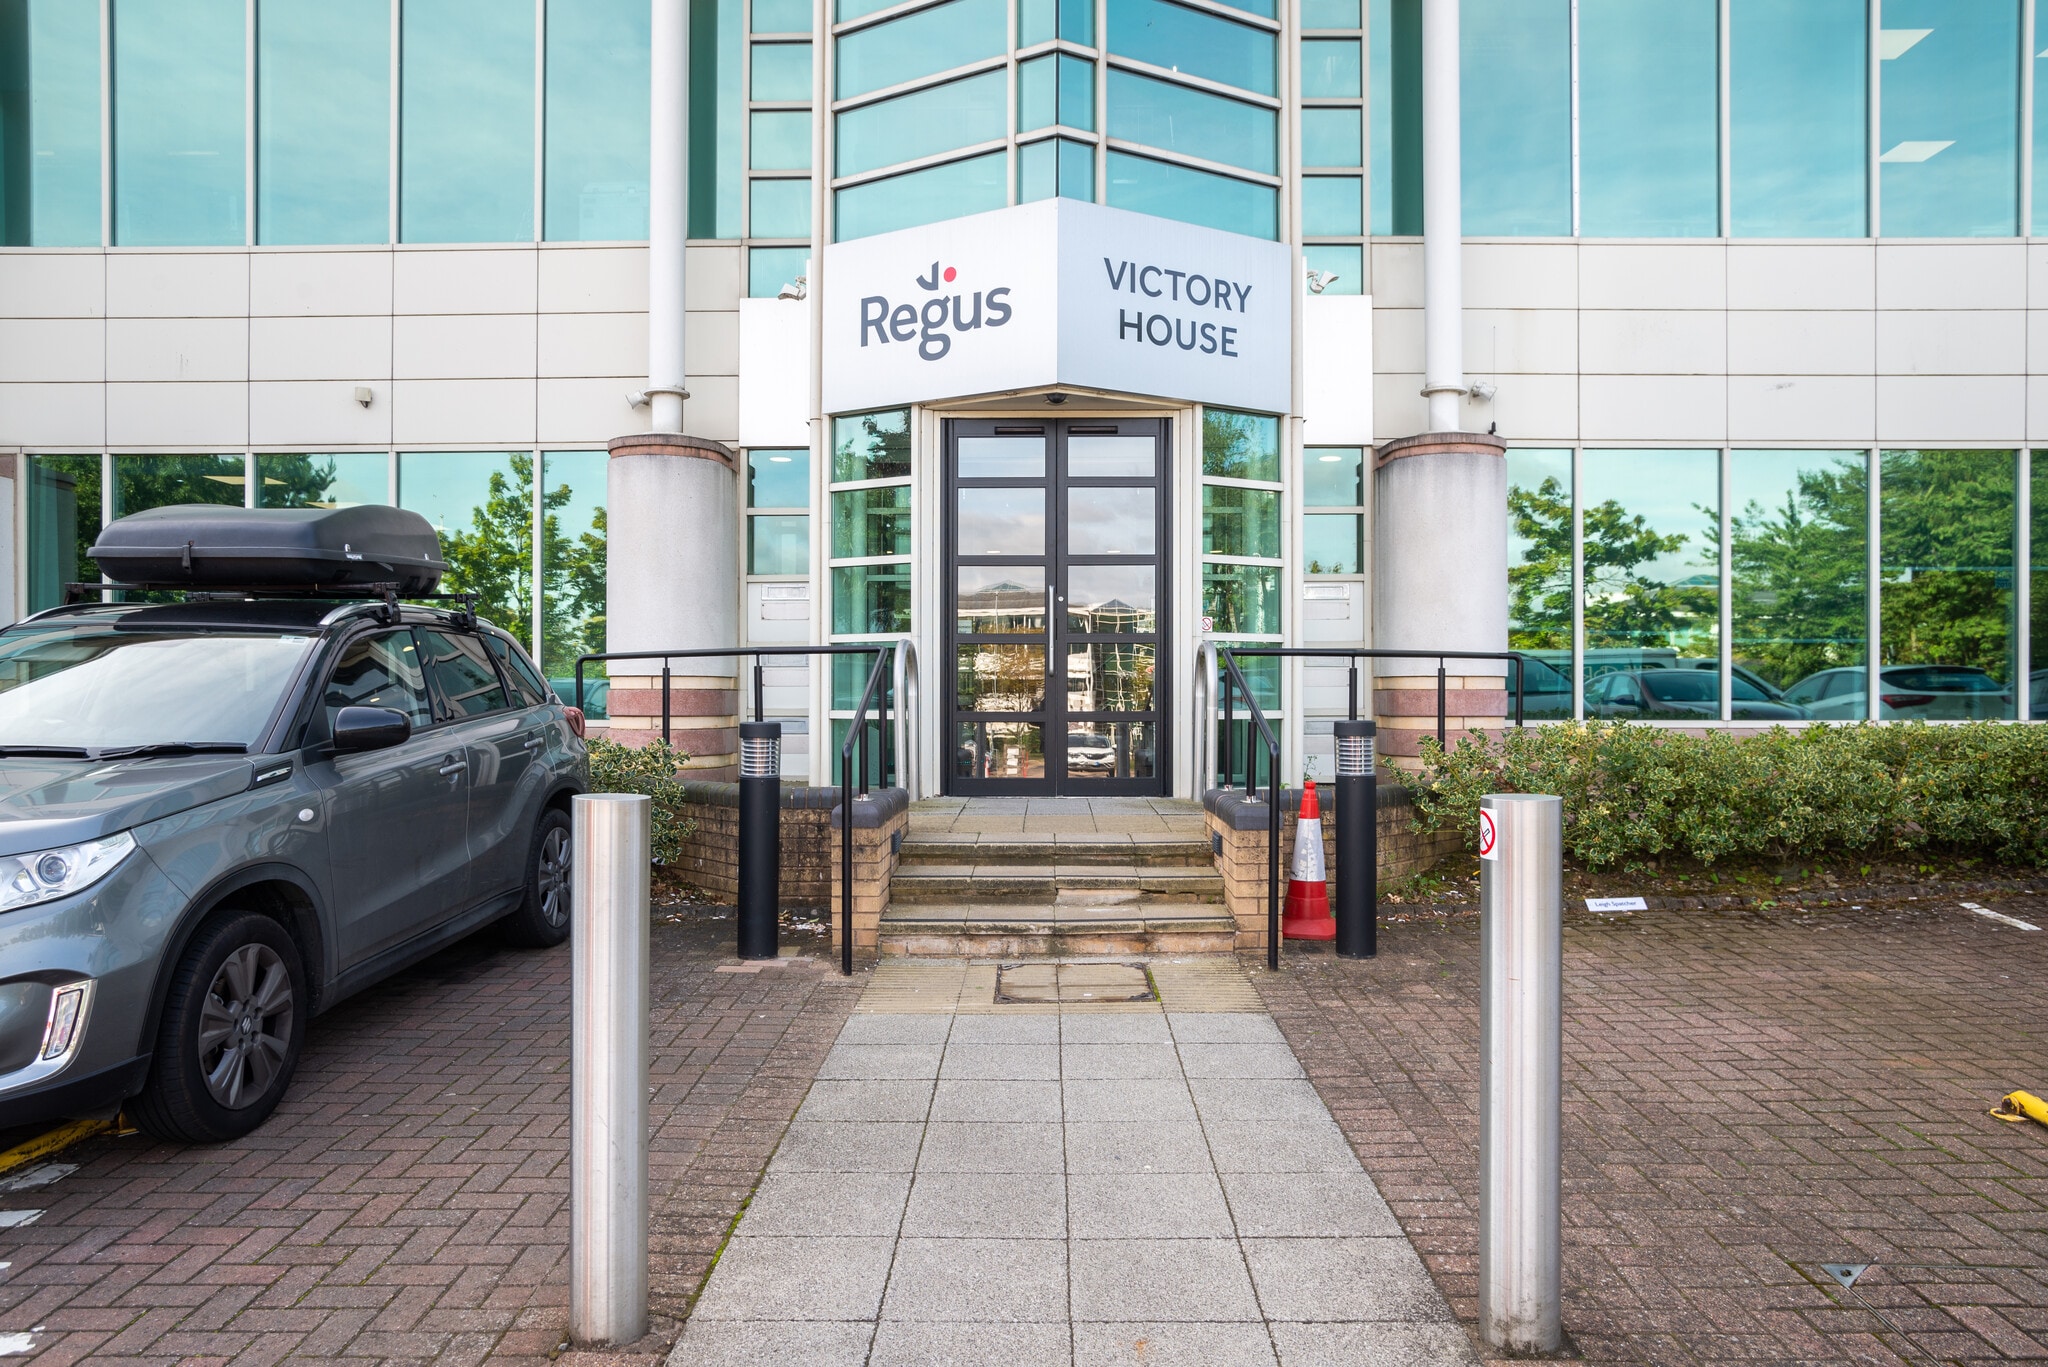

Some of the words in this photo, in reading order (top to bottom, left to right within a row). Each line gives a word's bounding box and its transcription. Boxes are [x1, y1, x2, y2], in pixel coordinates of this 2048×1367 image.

[1103, 257, 1252, 313] VICTORY
[860, 287, 1012, 361] Regus
[1119, 309, 1238, 358] HOUSE
